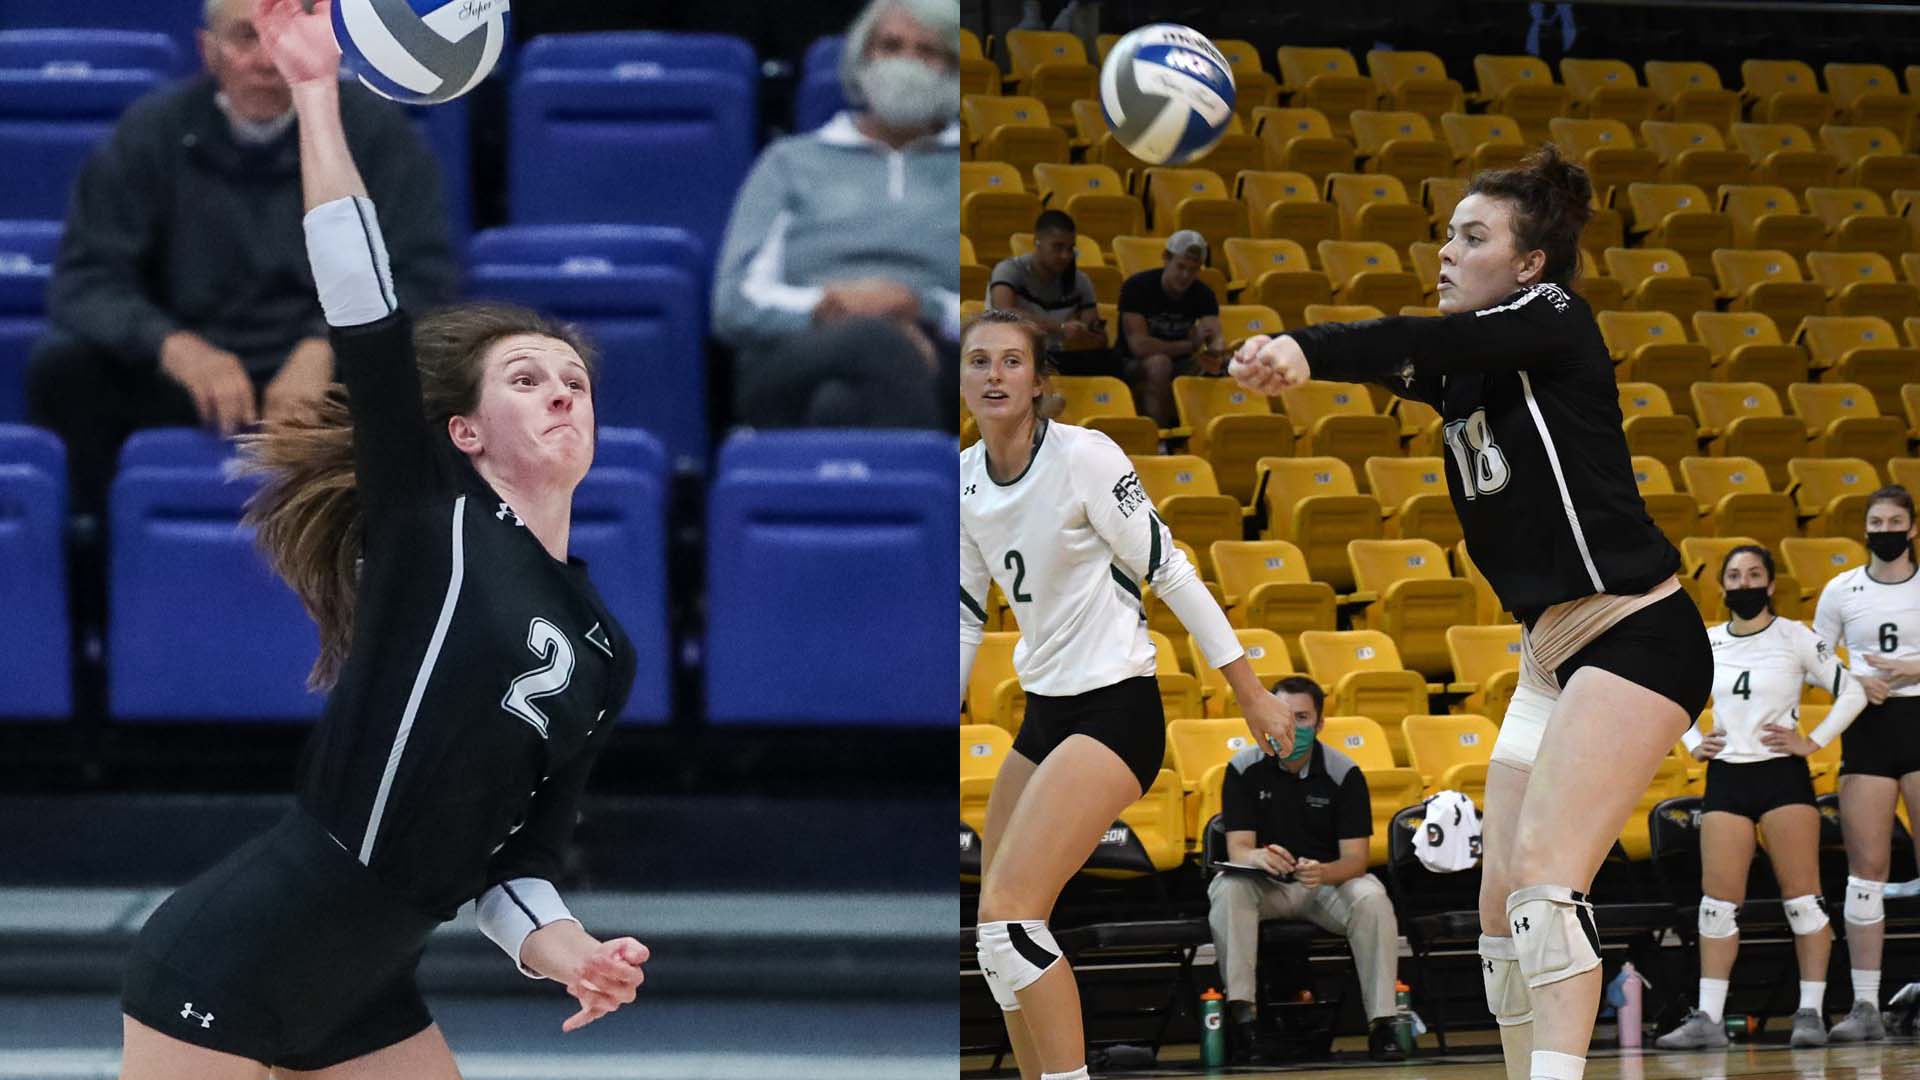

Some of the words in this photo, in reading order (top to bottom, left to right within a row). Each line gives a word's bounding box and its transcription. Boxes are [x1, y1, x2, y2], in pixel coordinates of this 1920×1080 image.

[1443, 406, 1511, 501] 18
[1004, 550, 1033, 602] 2
[1878, 622, 1899, 653] 6
[501, 617, 576, 739] 2
[1732, 670, 1752, 701] 4
[1205, 1012, 1220, 1031] G
